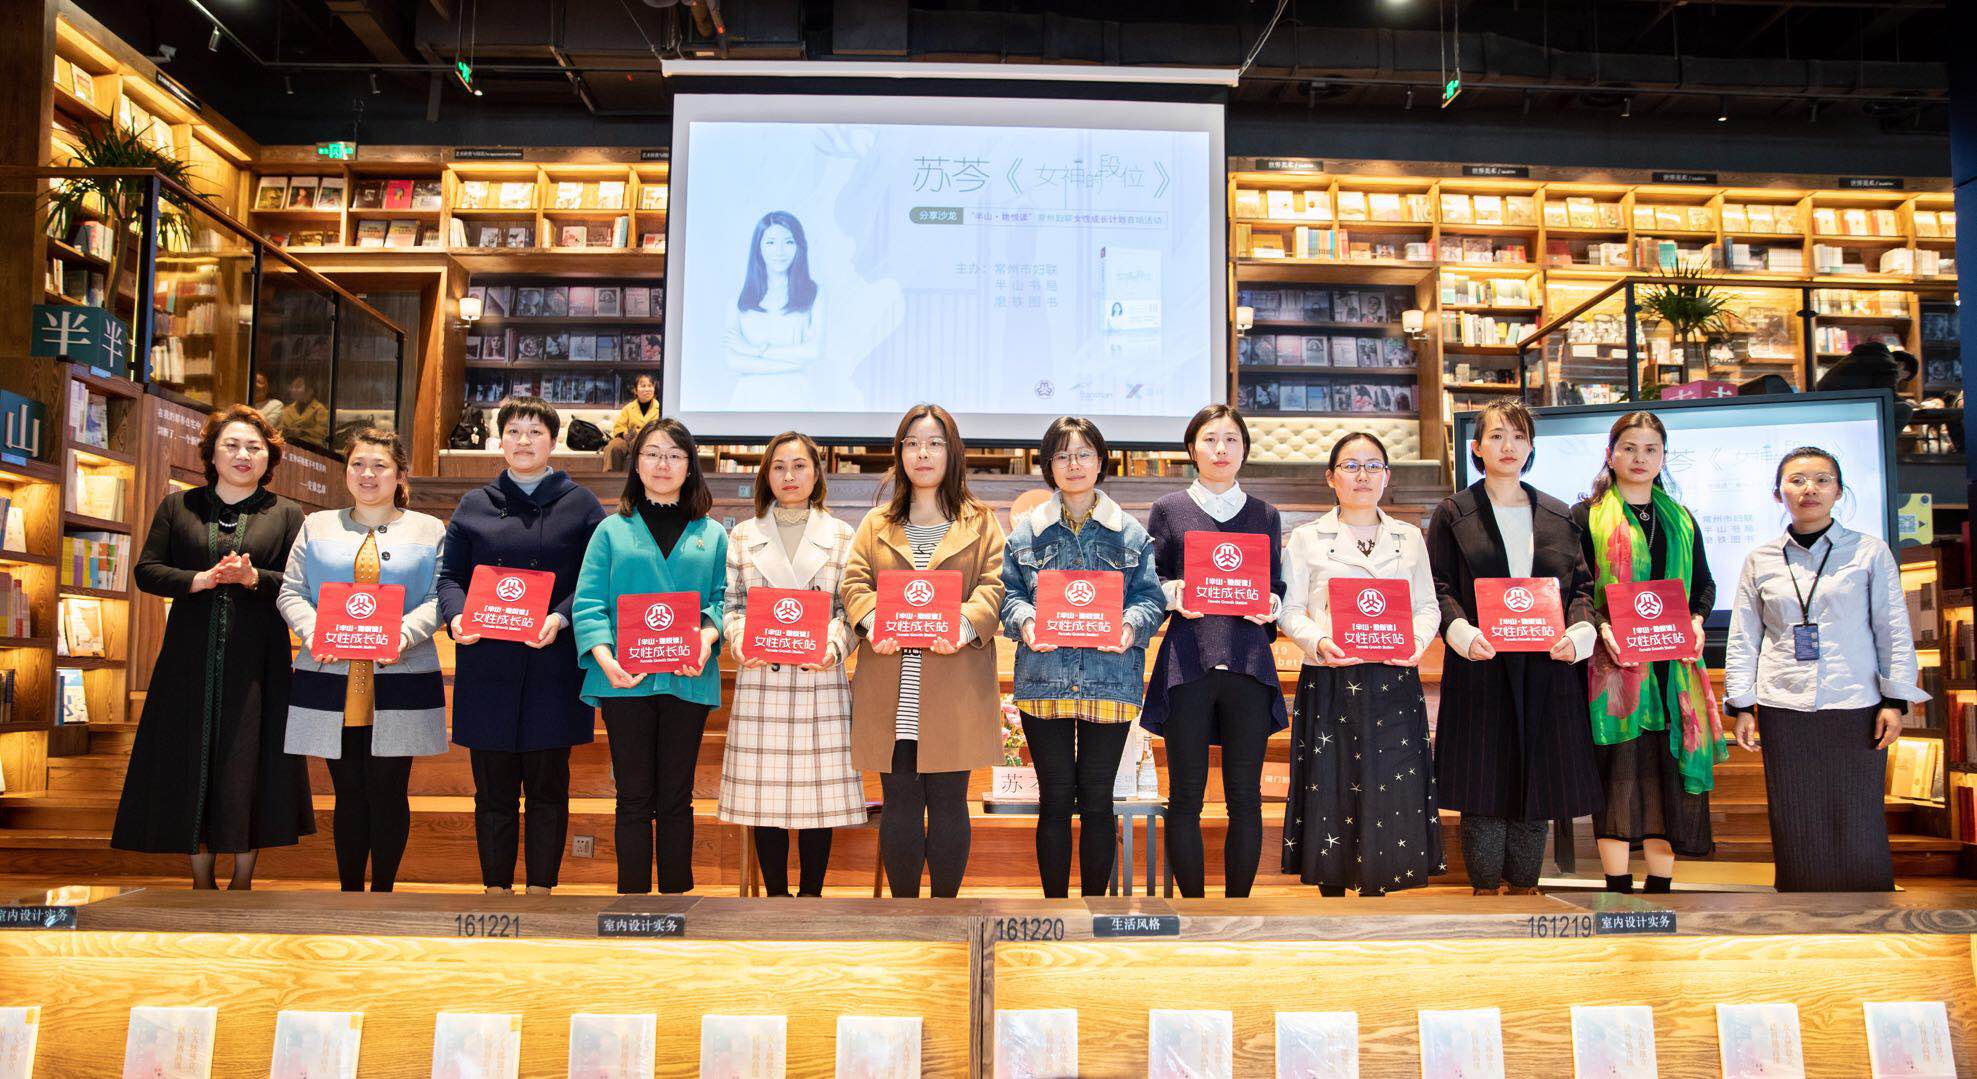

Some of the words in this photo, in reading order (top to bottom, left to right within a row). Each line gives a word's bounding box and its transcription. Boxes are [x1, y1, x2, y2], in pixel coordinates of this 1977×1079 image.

[41, 311, 92, 355] 半
[103, 318, 123, 368] 半
[6, 404, 40, 458] 山
[1196, 585, 1259, 600] 女性成长站
[472, 611, 534, 627] 女性成长站
[1046, 620, 1111, 632] 女性成长站
[885, 621, 949, 632] 女性成长站
[1491, 626, 1555, 637] 女性成长站
[325, 632, 389, 645] 女性成长站
[754, 636, 816, 650] 女性成长站
[1344, 632, 1405, 645] 女性成长站
[1626, 632, 1685, 648] 女性成长站
[628, 645, 691, 659] 女性成长站
[454, 914, 520, 938] 161221
[603, 919, 678, 932] 室内设计实务
[996, 917, 1065, 941] 161220
[1111, 917, 1161, 931] 生活风格
[1528, 916, 1592, 938] 161219
[1601, 916, 1671, 929] 室内设计实务
